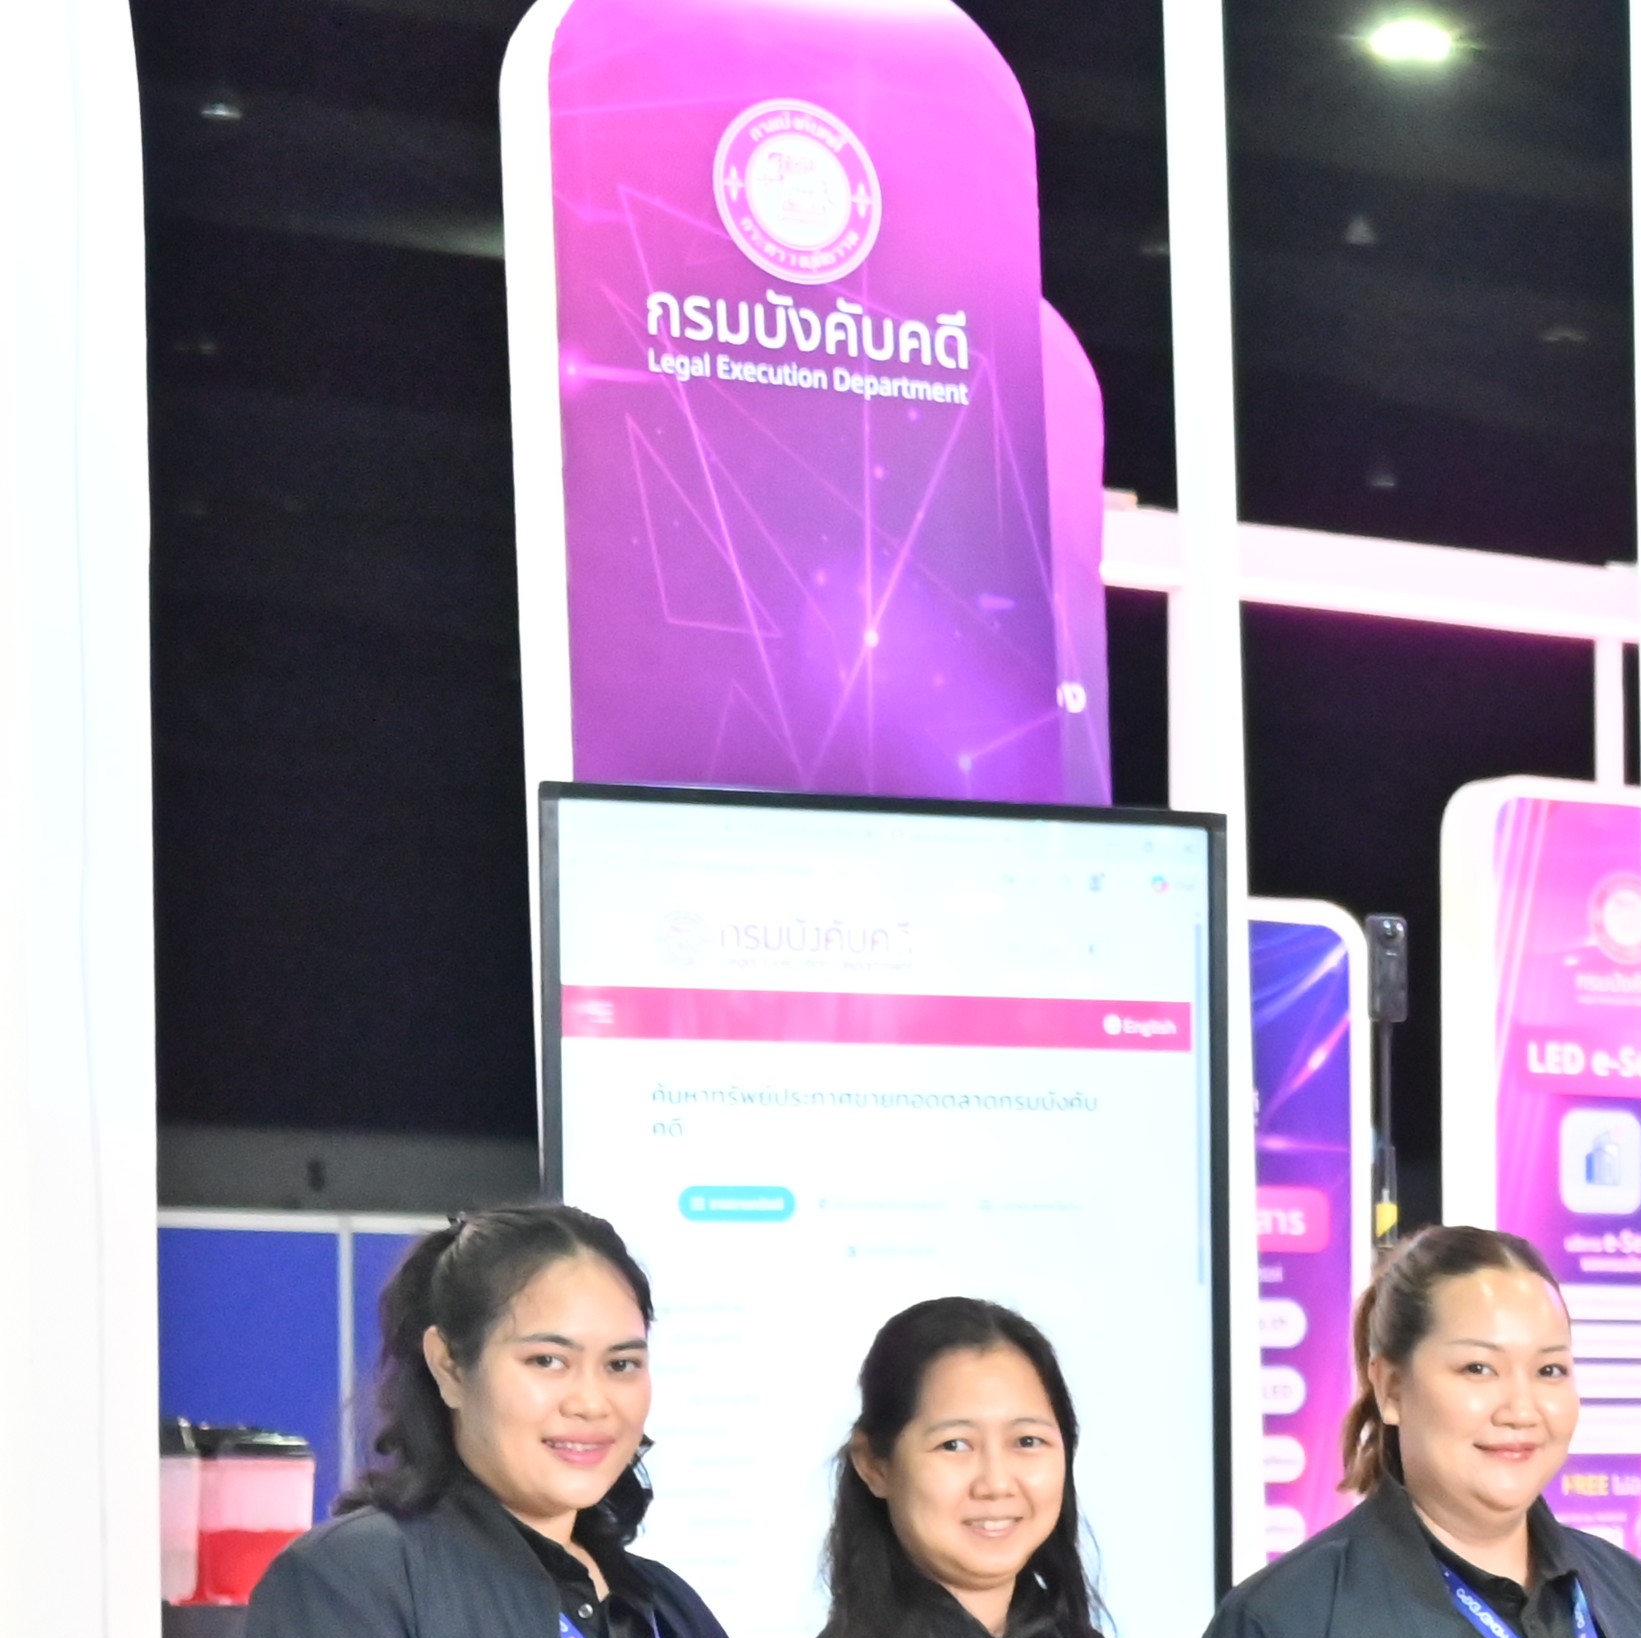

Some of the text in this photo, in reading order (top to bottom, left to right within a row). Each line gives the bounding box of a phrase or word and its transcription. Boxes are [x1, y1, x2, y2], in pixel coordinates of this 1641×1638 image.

[646, 289, 969, 370] กรมบังคับคดี
[647, 347, 970, 406] Legal Execution Department
[1527, 1041, 1585, 1075] LED
